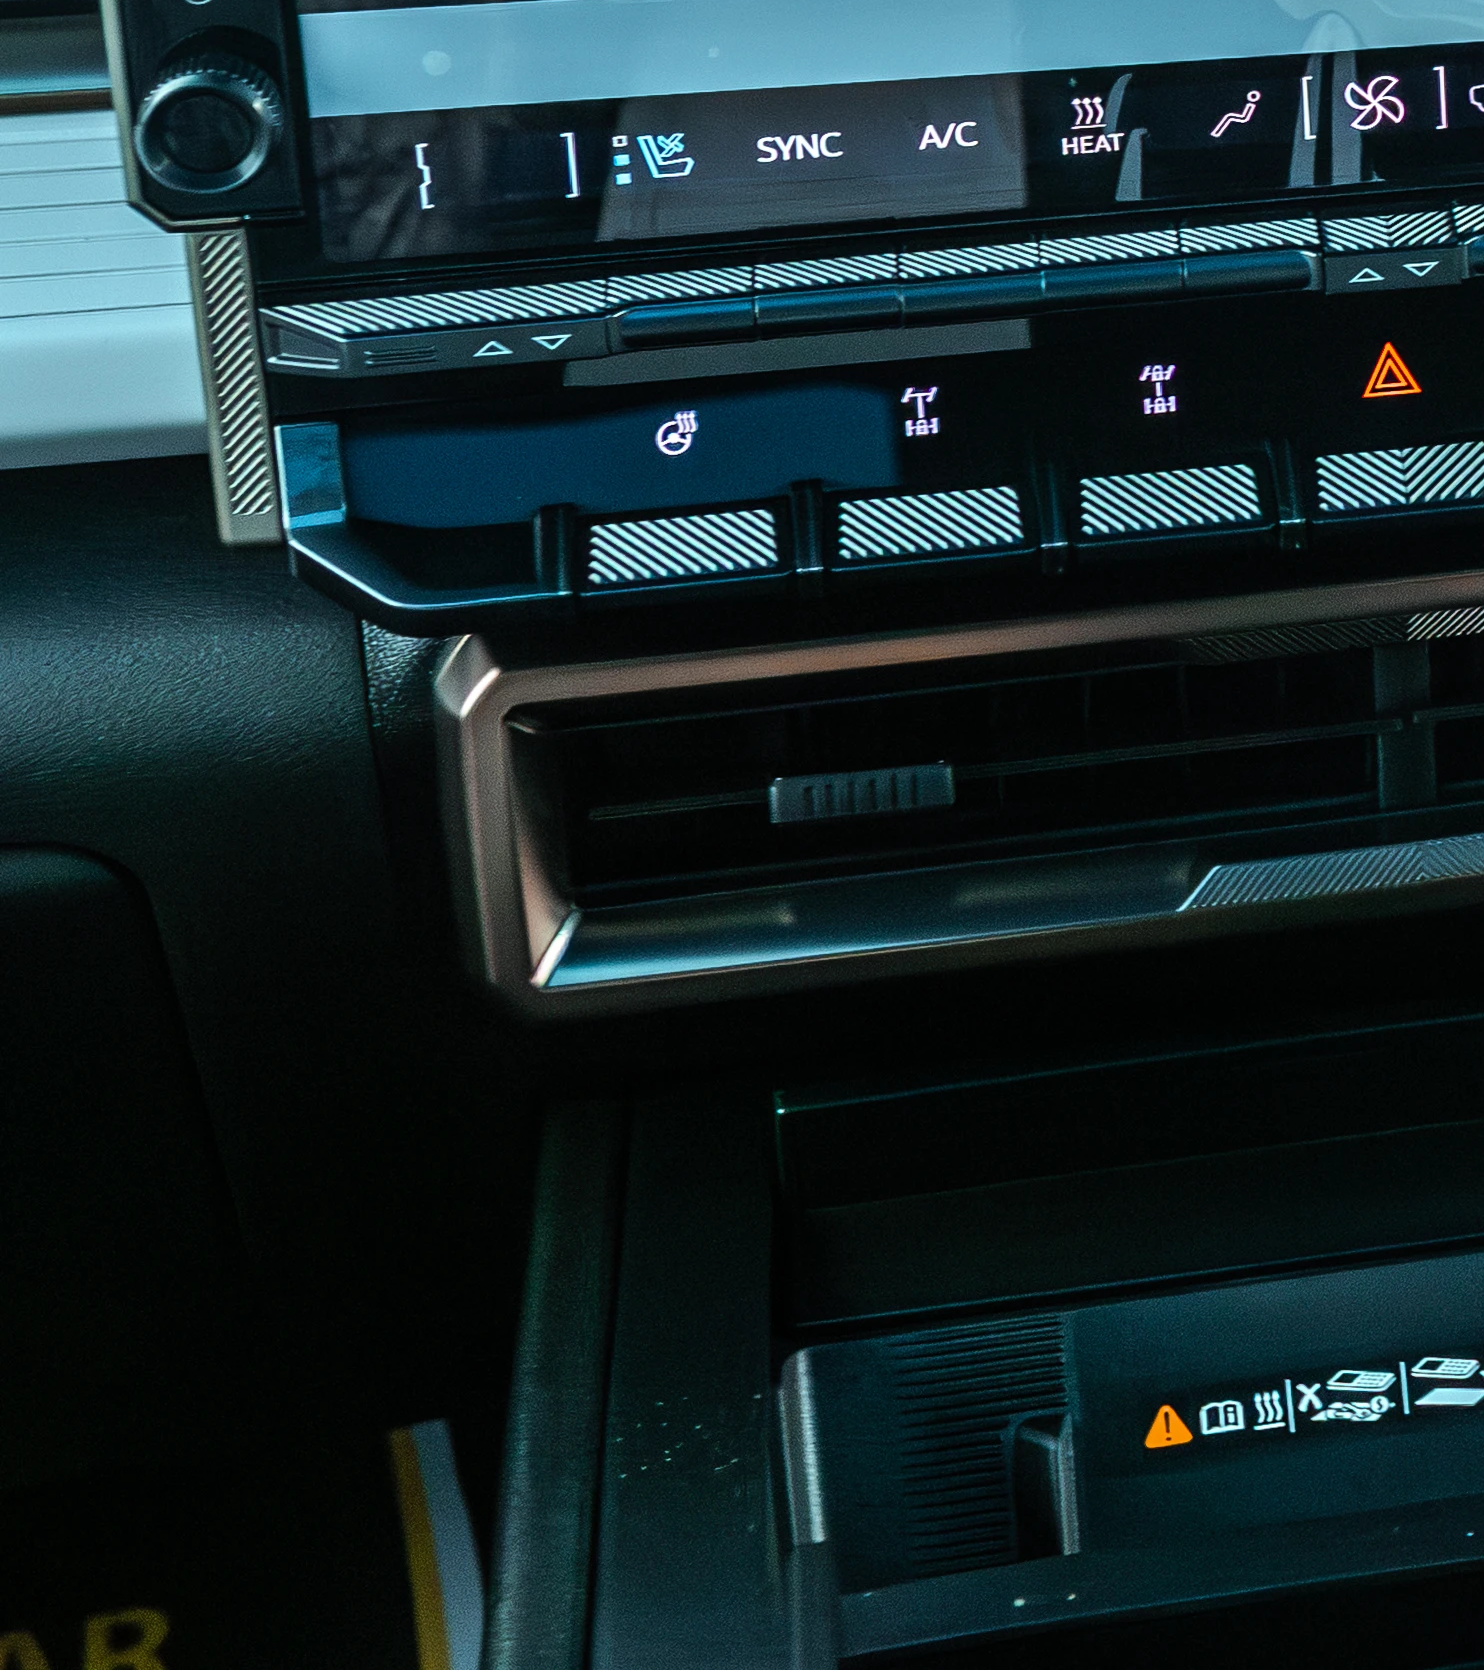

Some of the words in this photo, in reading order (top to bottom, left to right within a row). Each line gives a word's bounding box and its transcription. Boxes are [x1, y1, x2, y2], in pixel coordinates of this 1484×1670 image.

[755, 131, 845, 164] SYNC
[918, 121, 979, 150] A/C
[1060, 132, 1126, 156] HEAT
